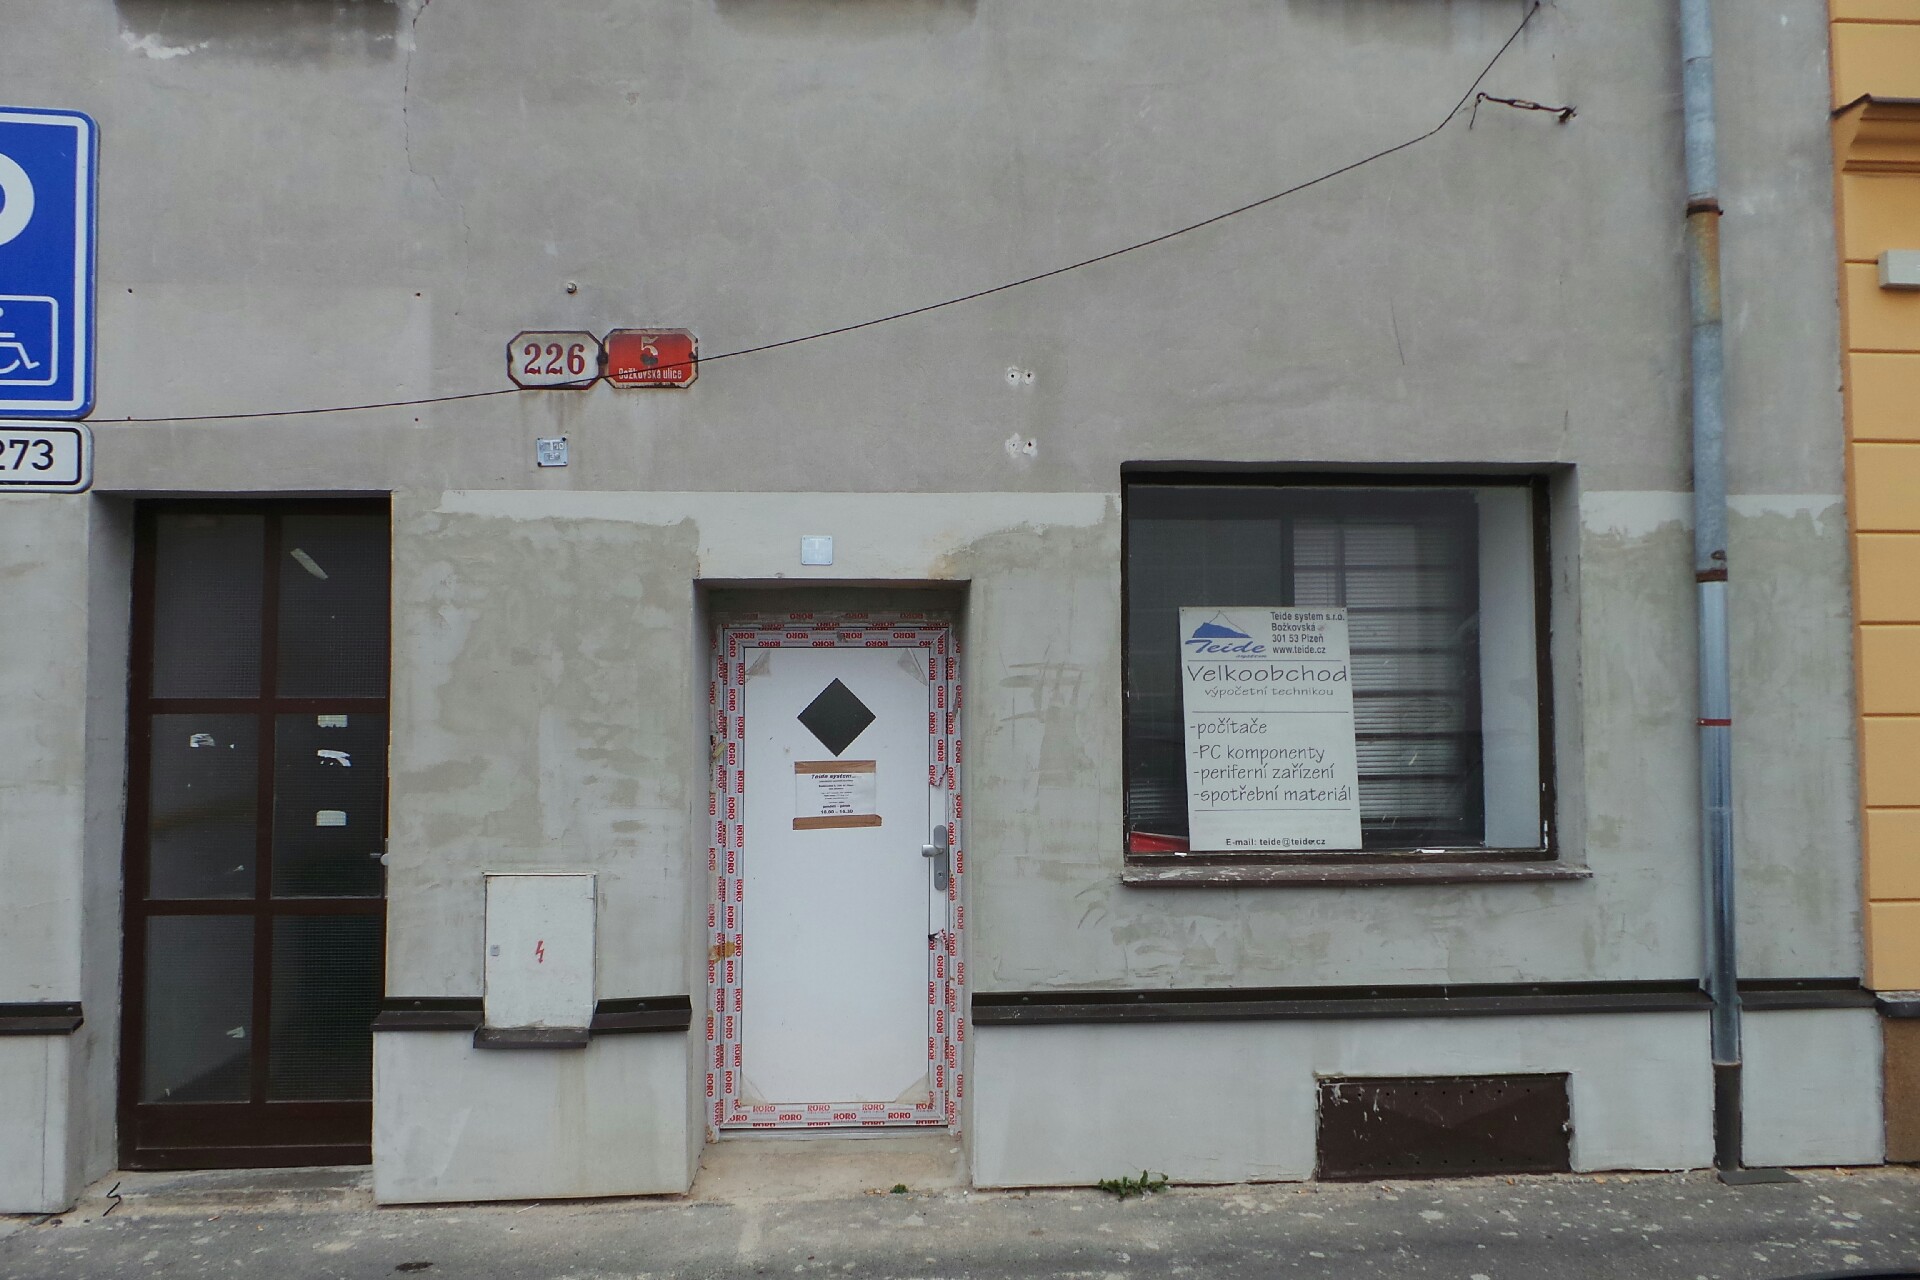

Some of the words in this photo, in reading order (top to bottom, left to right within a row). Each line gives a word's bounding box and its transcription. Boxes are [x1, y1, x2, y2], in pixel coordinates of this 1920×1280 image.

[524, 343, 585, 375] 226
[662, 367, 682, 379] ulice
[0, 439, 54, 470] 73
[1270, 611, 1292, 620] Teide
[1294, 612, 1324, 622] system
[1271, 622, 1316, 631] Božkovská
[1271, 633, 1286, 643] 301
[1288, 633, 1299, 642] 53
[1301, 633, 1324, 643] Plzeň
[1185, 639, 1266, 653] Teide
[1272, 645, 1327, 653] www.teide.cz
[1187, 664, 1348, 682] Velkoobchod
[1204, 686, 1268, 698] výpočetní
[1271, 687, 1334, 696] technikou
[1227, 745, 1325, 765] komponenty
[1272, 763, 1335, 779] zařízení
[1284, 785, 1352, 801] materiál
[1226, 838, 1257, 846] E-mail:
[1260, 837, 1326, 847] teide@teide.cz
